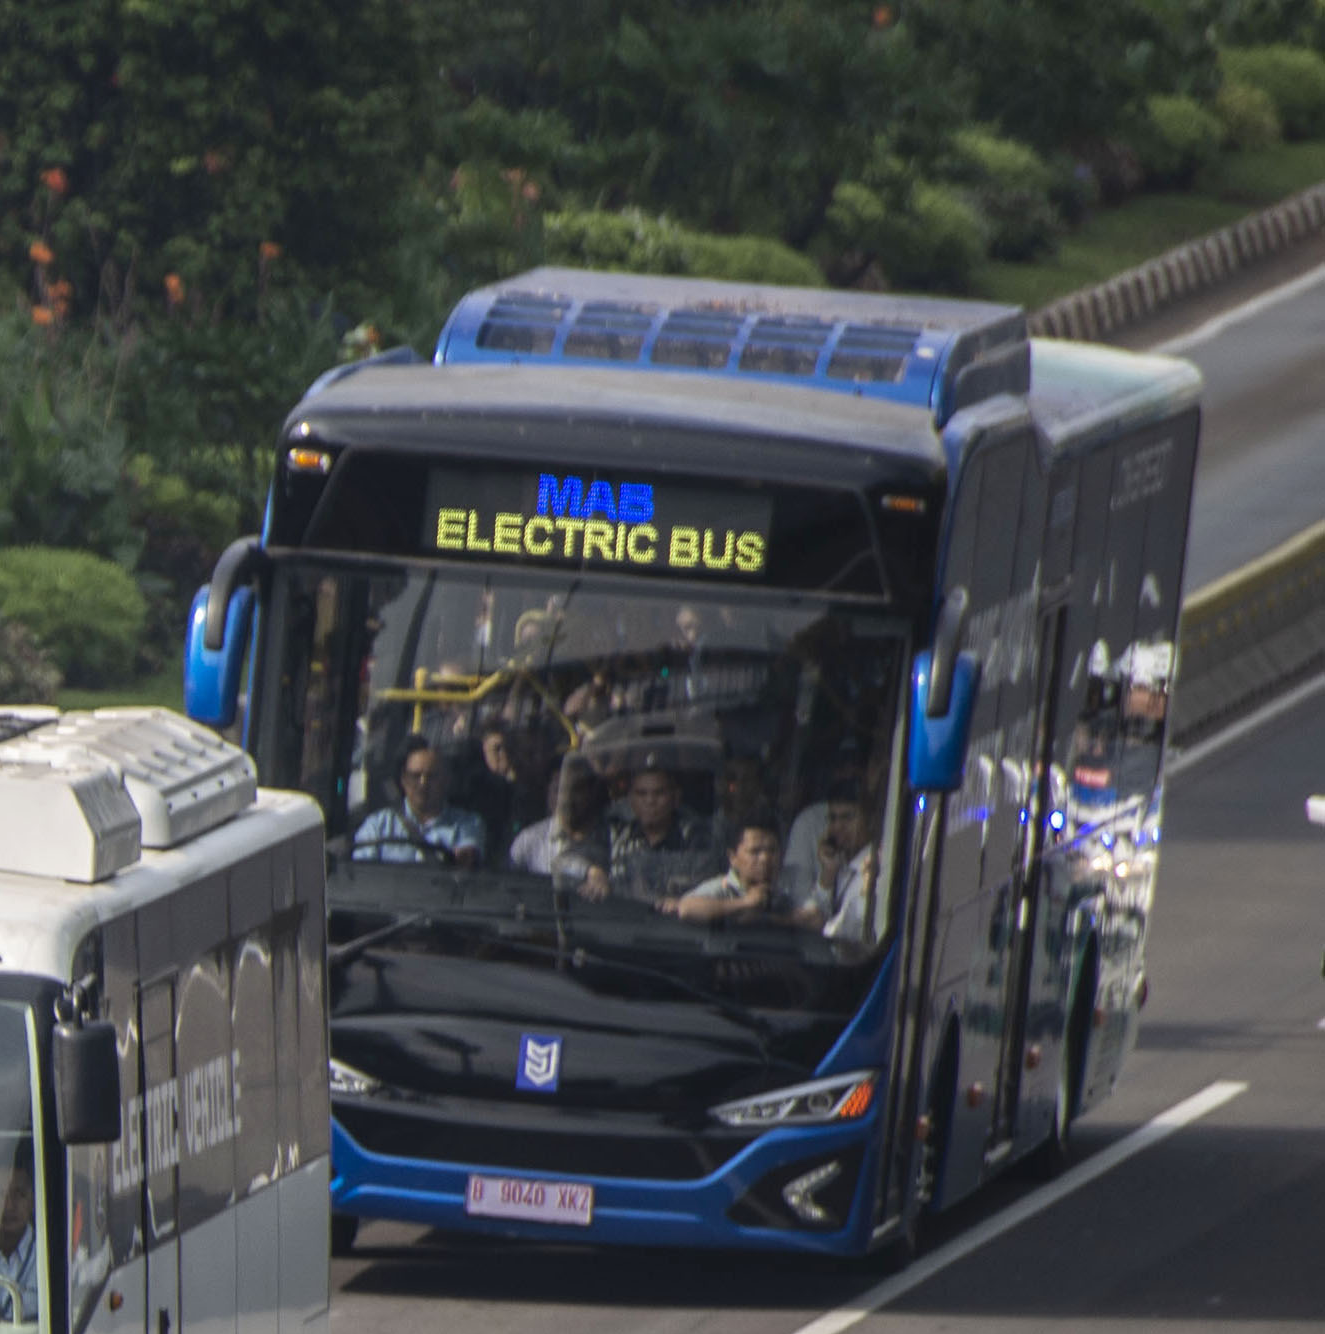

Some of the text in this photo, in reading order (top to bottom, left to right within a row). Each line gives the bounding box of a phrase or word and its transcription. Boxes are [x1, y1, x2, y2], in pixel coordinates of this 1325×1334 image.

[537, 474, 655, 524] MAB
[436, 508, 766, 571] ELECTRIC BUS
[184, 1048, 241, 1157] VEHICLE
